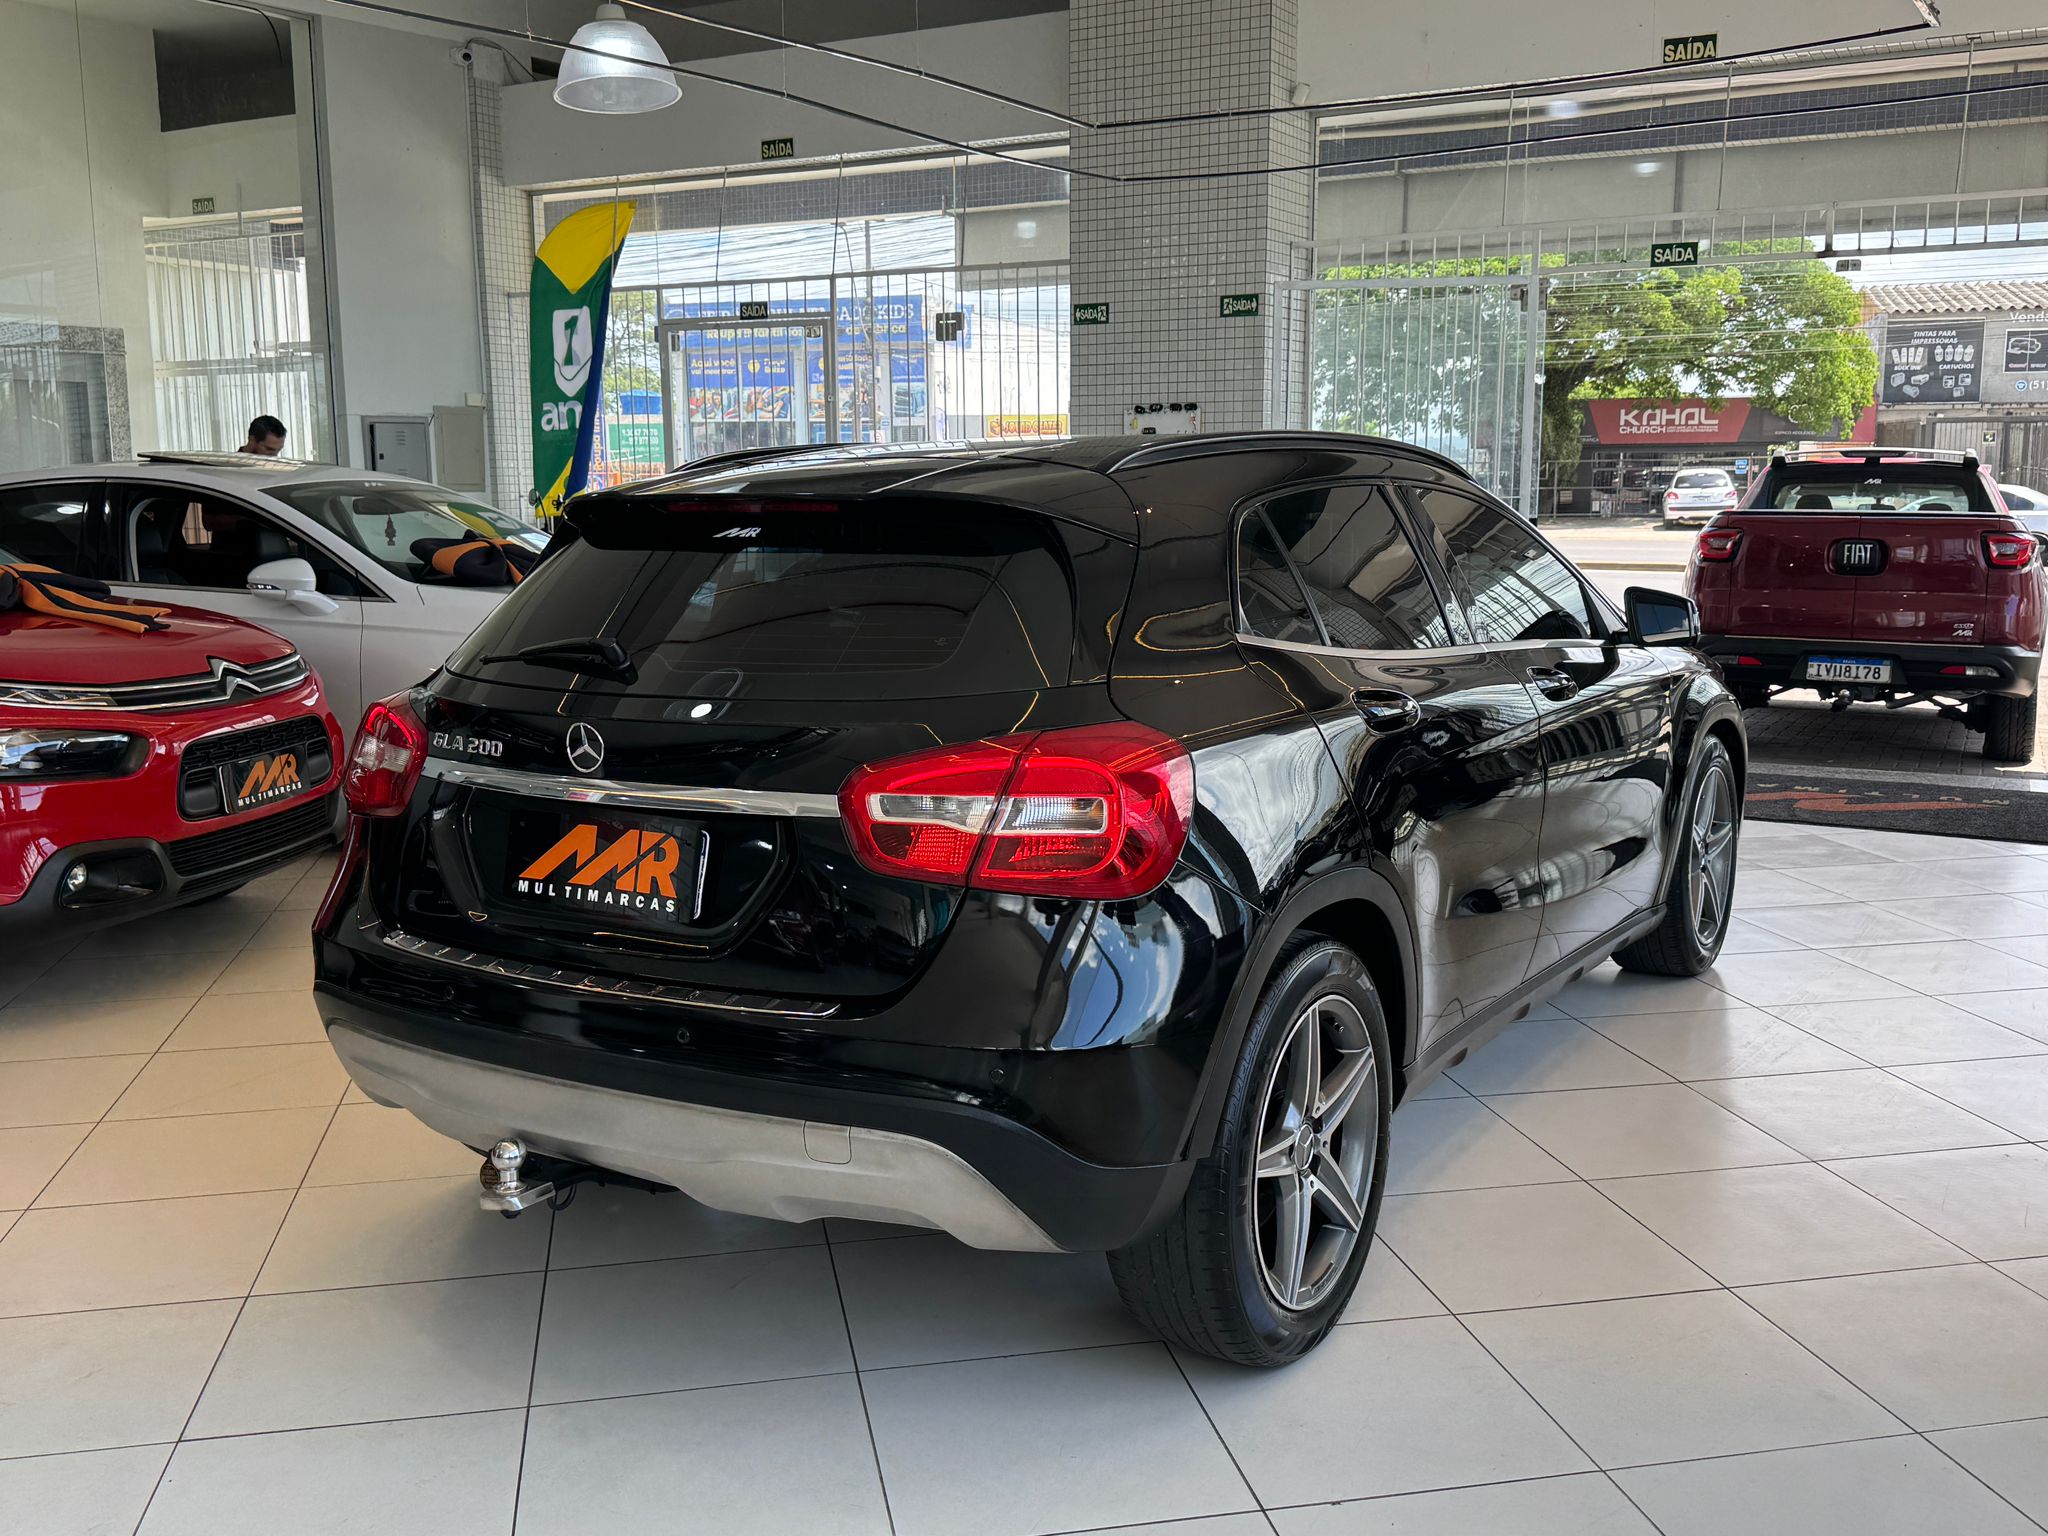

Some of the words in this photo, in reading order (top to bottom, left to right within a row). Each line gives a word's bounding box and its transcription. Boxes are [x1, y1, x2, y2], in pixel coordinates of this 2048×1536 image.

[1664, 37, 1716, 62] SAÍDA
[762, 140, 793, 158] SAÍDA
[1653, 244, 1695, 263] SAÍDA
[742, 303, 767, 318] SAÍDA
[1232, 296, 1251, 311] SAÍDA
[1080, 308, 1097, 321] SAÍDA
[2009, 311, 2048, 323] Vend
[1913, 330, 1938, 338] TINTAS
[540, 399, 584, 432] an
[1619, 407, 1719, 426] KAHAL
[1619, 425, 1666, 434] CHURCH
[1843, 544, 1873, 564] FIAT
[433, 732, 464, 751] GLA
[467, 737, 503, 757] 200
[238, 780, 302, 807] MULTIMARCAS
[518, 879, 678, 913] MULTIMARCAS
